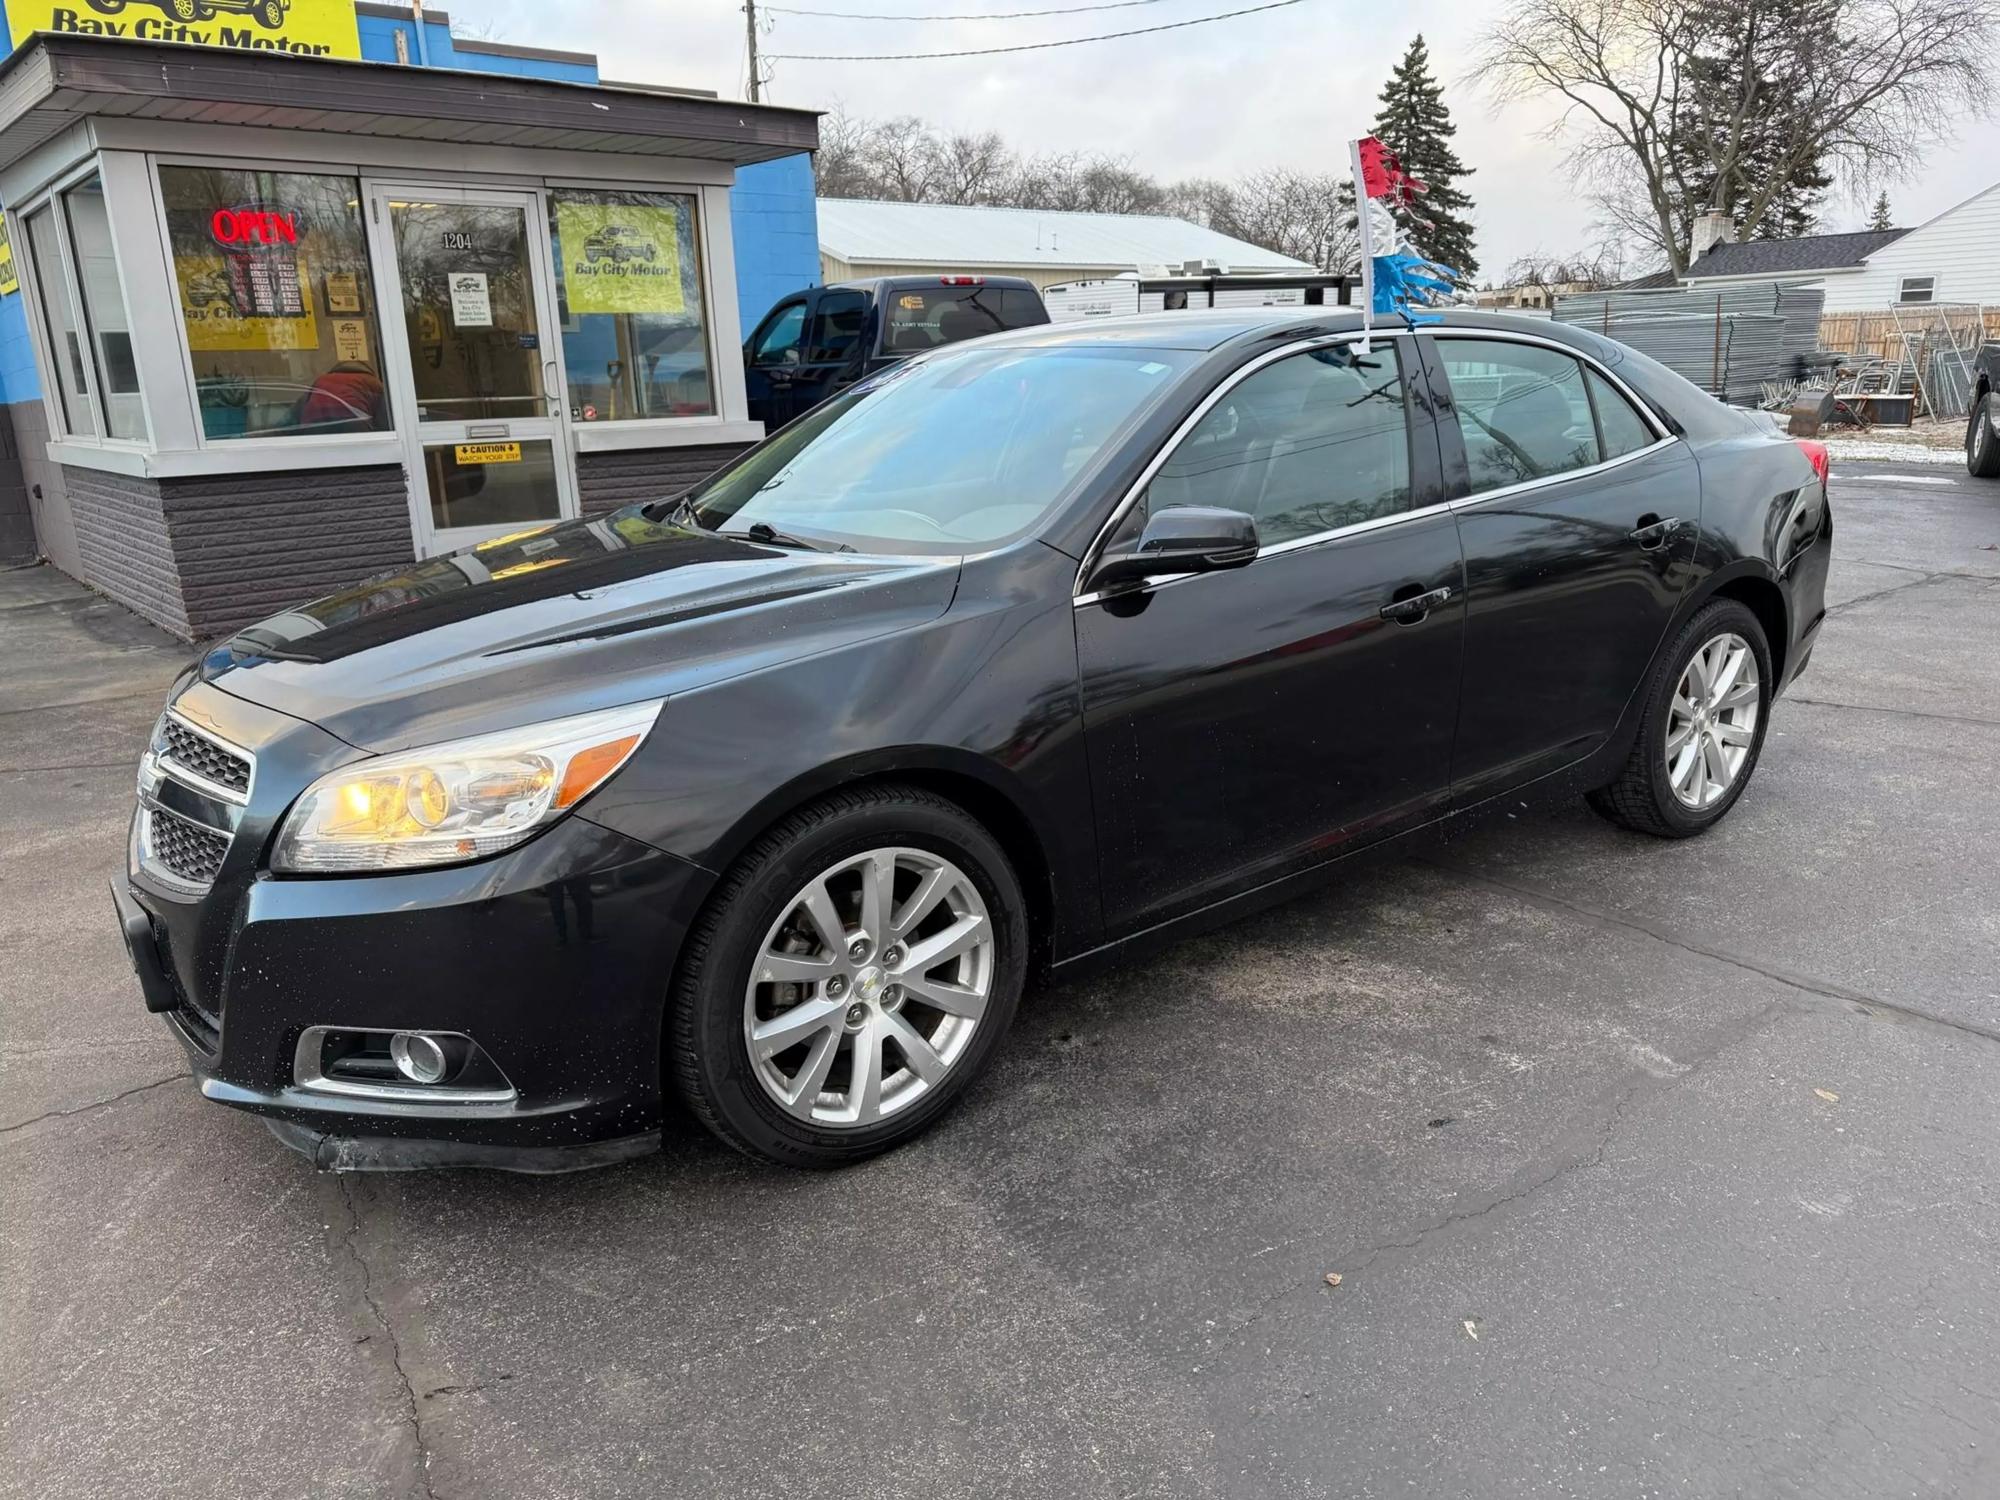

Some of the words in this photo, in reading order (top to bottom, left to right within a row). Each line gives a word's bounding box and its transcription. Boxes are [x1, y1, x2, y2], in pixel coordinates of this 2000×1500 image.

[52, 7, 127, 37] Bay
[135, 18, 212, 44] City
[219, 26, 331, 56] Motor
[212, 209, 297, 244] OPEN
[443, 232, 472, 249] 1204
[575, 262, 600, 277] Bay
[602, 262, 629, 278] City
[630, 263, 671, 276] Motor
[184, 308, 209, 321] ay
[470, 444, 506, 453] CAUTION
